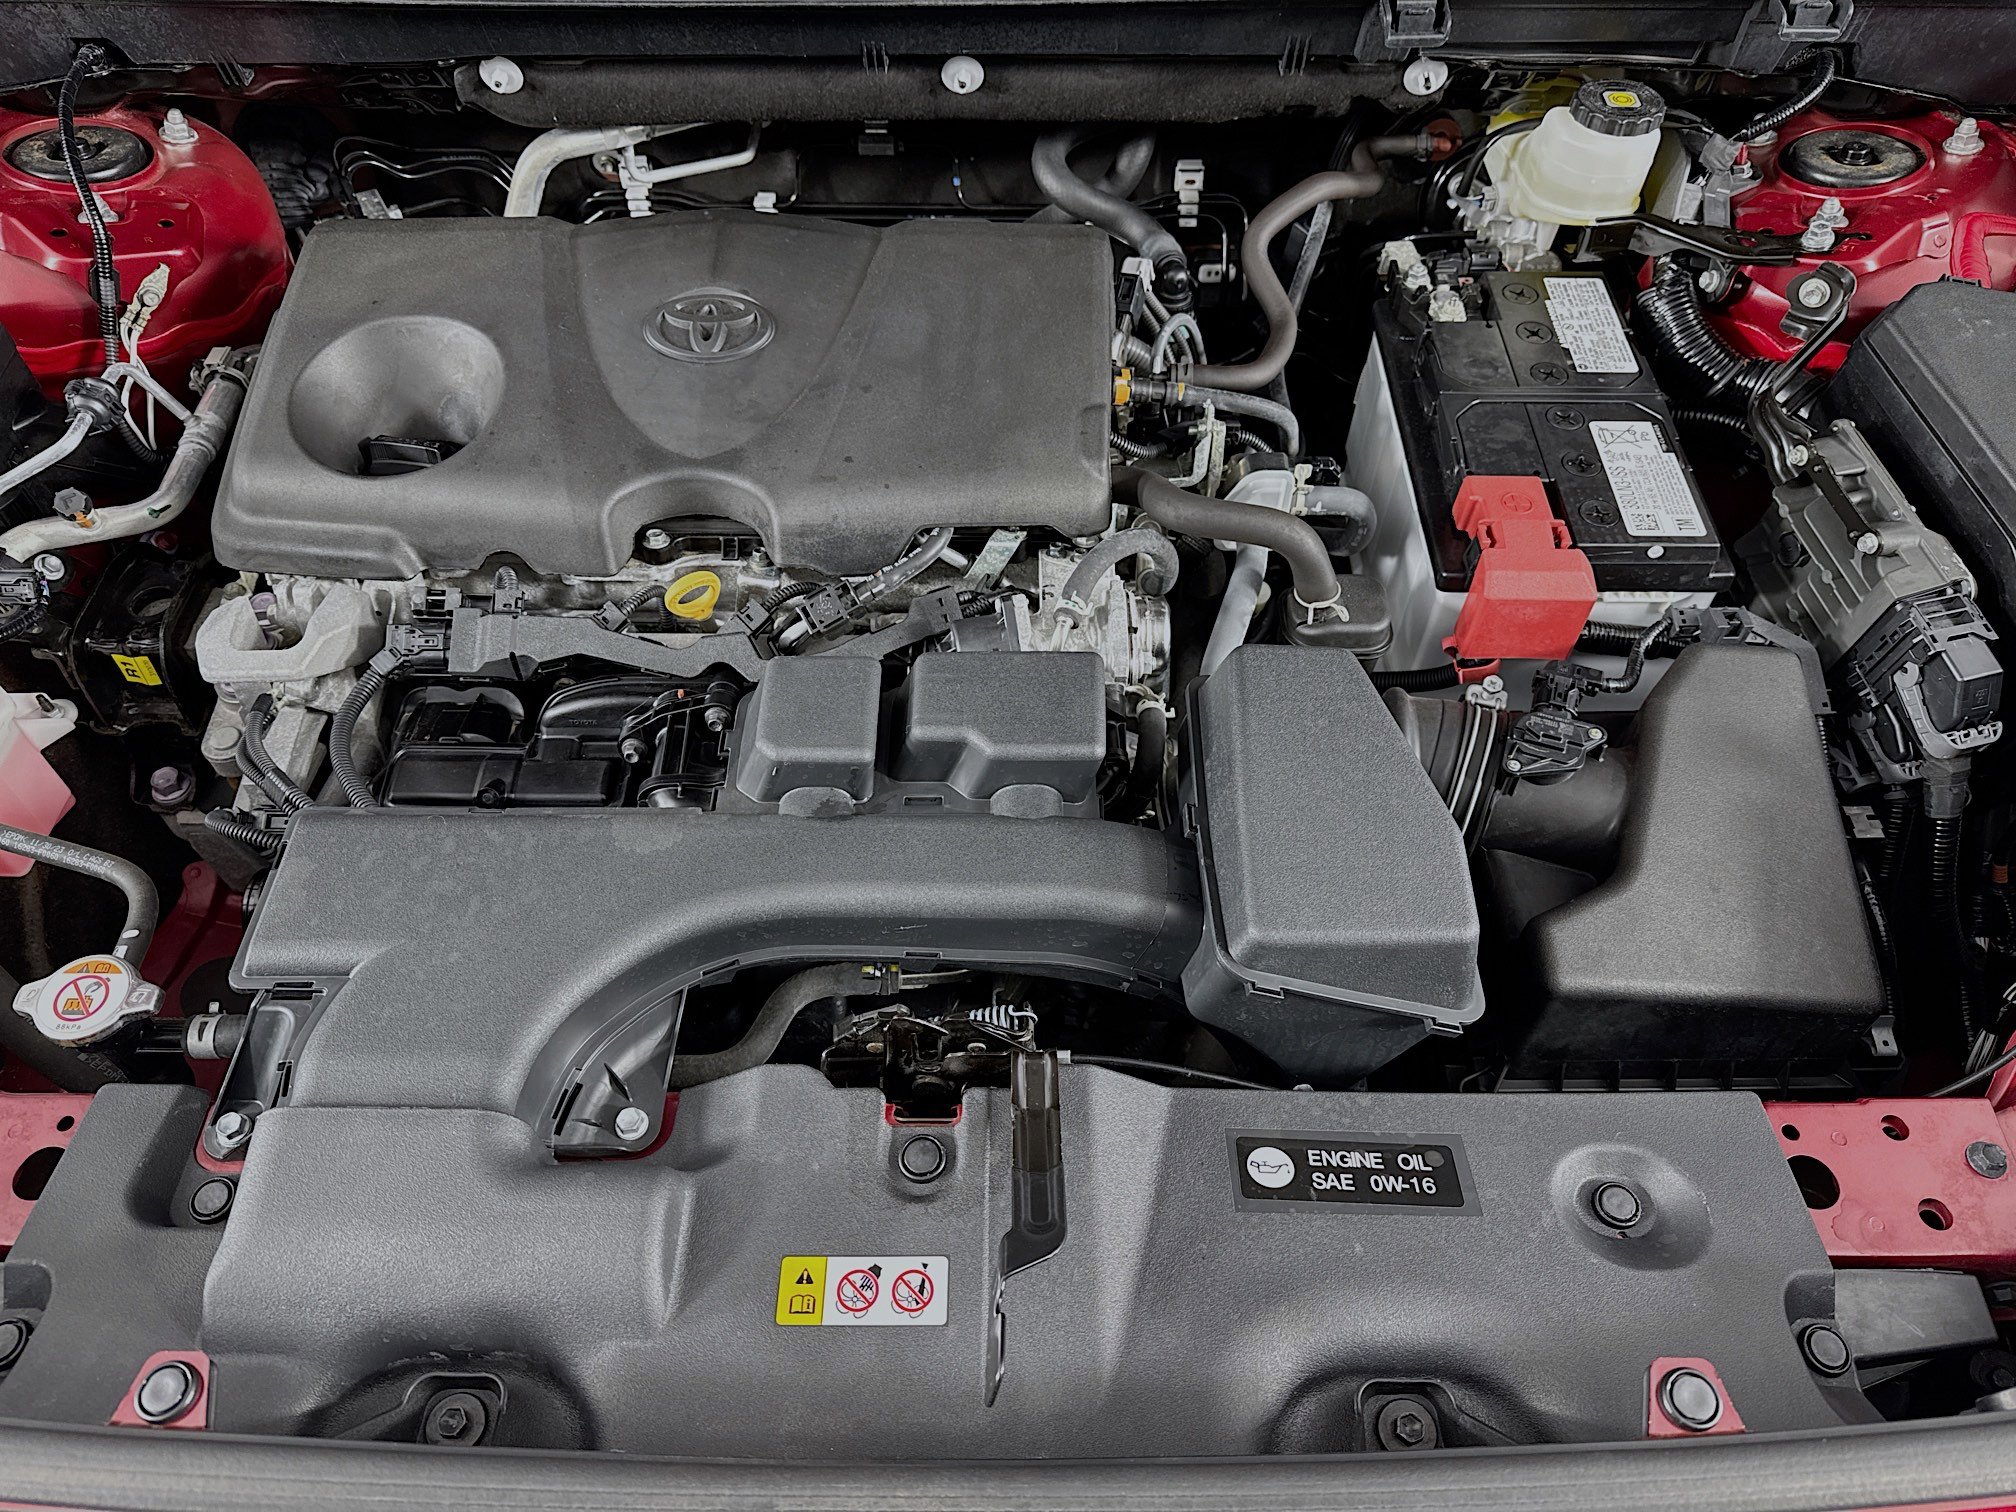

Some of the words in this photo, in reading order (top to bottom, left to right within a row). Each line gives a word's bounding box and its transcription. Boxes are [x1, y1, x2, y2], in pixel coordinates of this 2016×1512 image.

[1675, 518, 1696, 531] TM
[30, 838, 65, 853] 11/30/23
[55, 1023, 82, 1031] 88kPa
[1307, 1149, 1385, 1169] ENGINE
[1397, 1153, 1433, 1171] OIL
[1312, 1173, 1355, 1191] SAE
[1370, 1174, 1437, 1195] 0W-16
